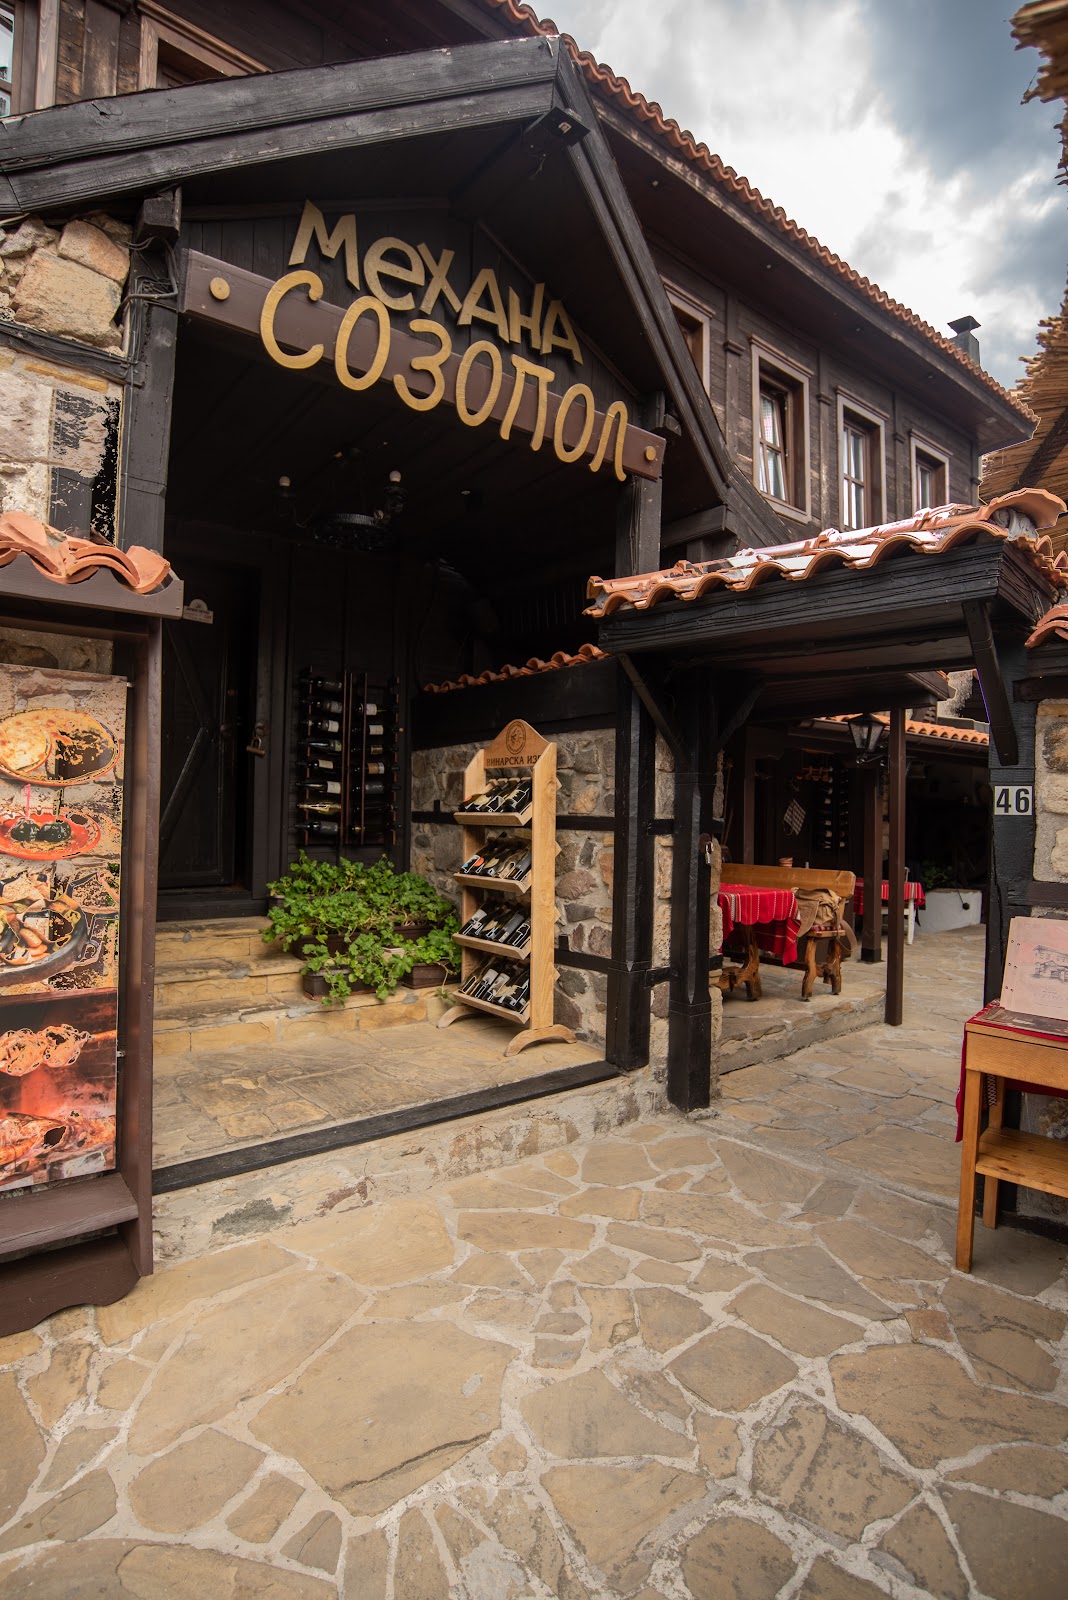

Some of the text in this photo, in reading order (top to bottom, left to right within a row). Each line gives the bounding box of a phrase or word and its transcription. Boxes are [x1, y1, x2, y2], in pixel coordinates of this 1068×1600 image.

[260, 270, 628, 482] СОЗОПОЛ
[486, 756, 524, 767] ВИНАРСКА
[996, 788, 1030, 813] 46
